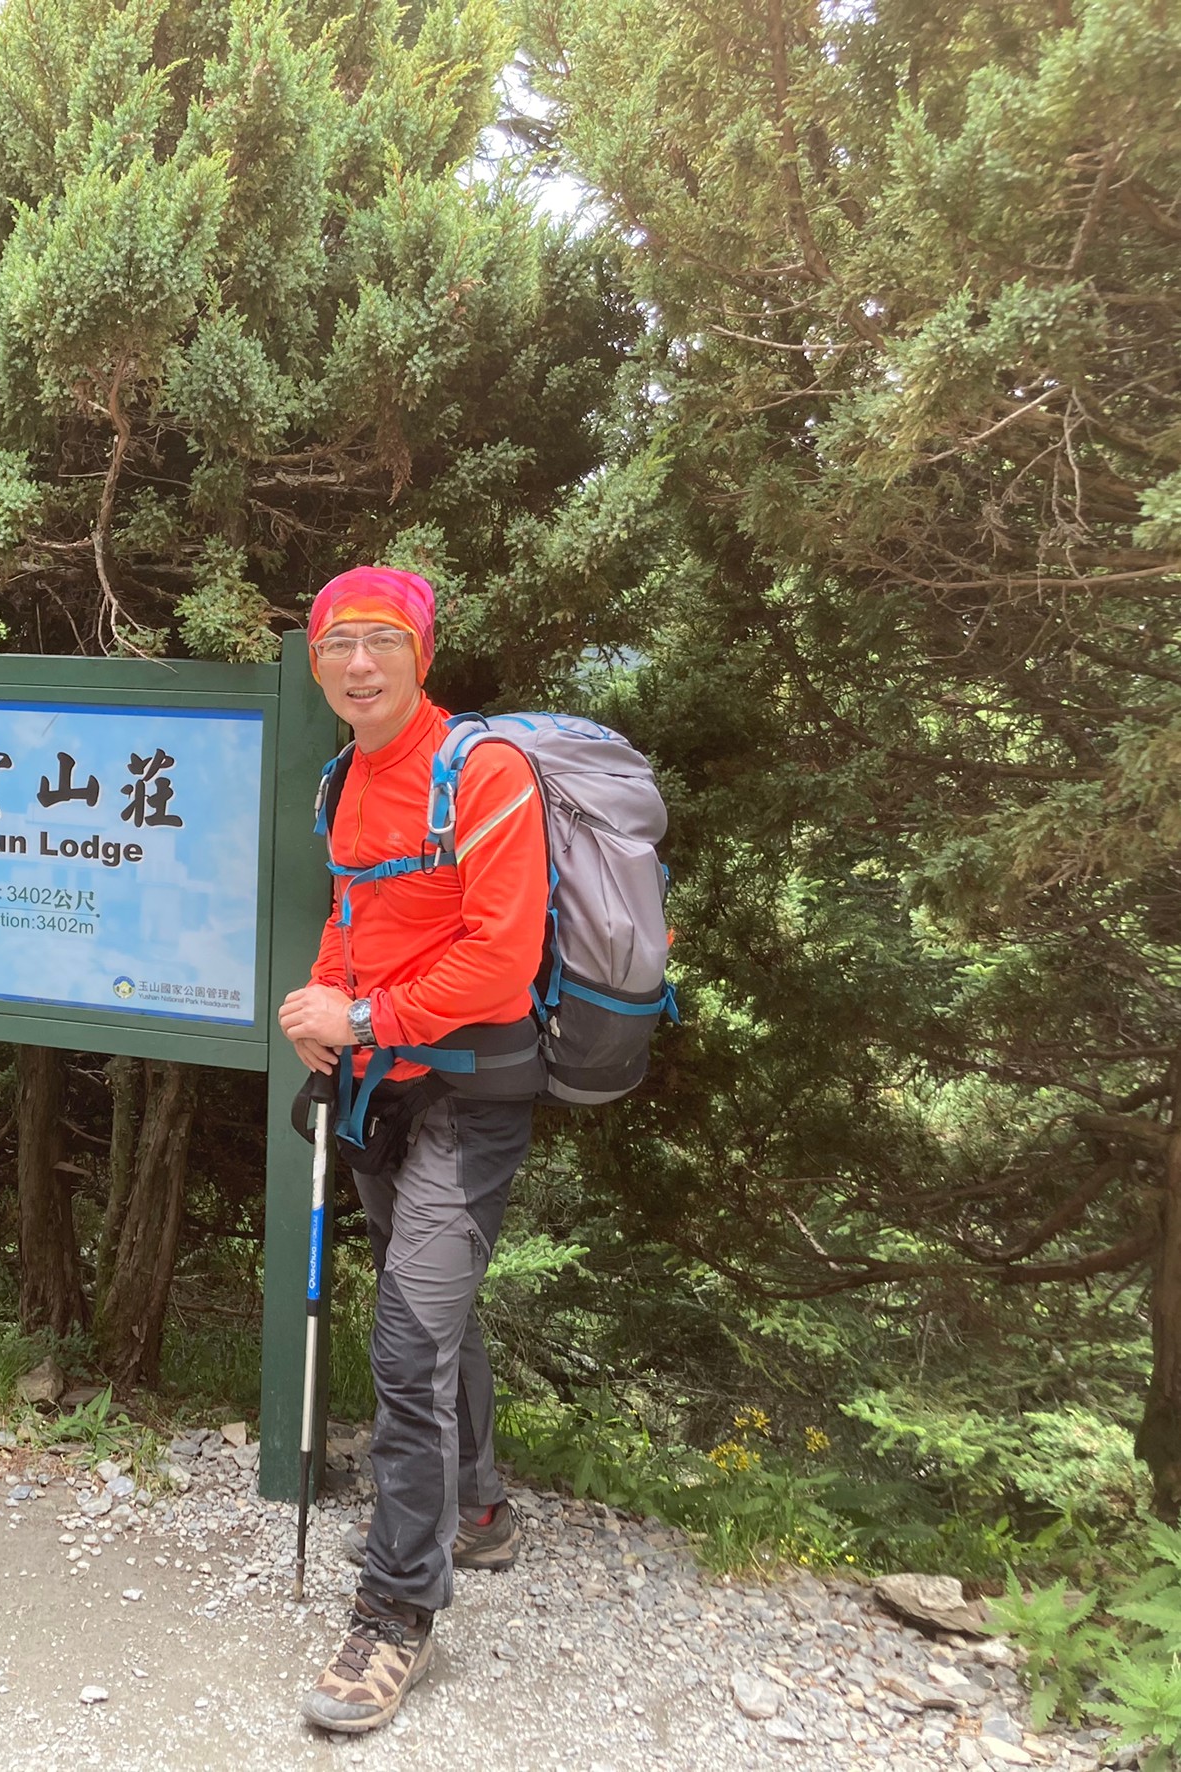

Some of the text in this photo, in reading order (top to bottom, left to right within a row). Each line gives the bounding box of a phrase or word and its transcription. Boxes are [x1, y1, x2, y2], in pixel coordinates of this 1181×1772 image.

[40, 831, 143, 866] Lodge
[138, 981, 240, 1001] 玉山國家公園管理處
[138, 993, 160, 1001] Yushan
[161, 996, 184, 1004] National
[200, 1000, 240, 1010] Headquarters
[308, 1246, 317, 1290] Quechua
